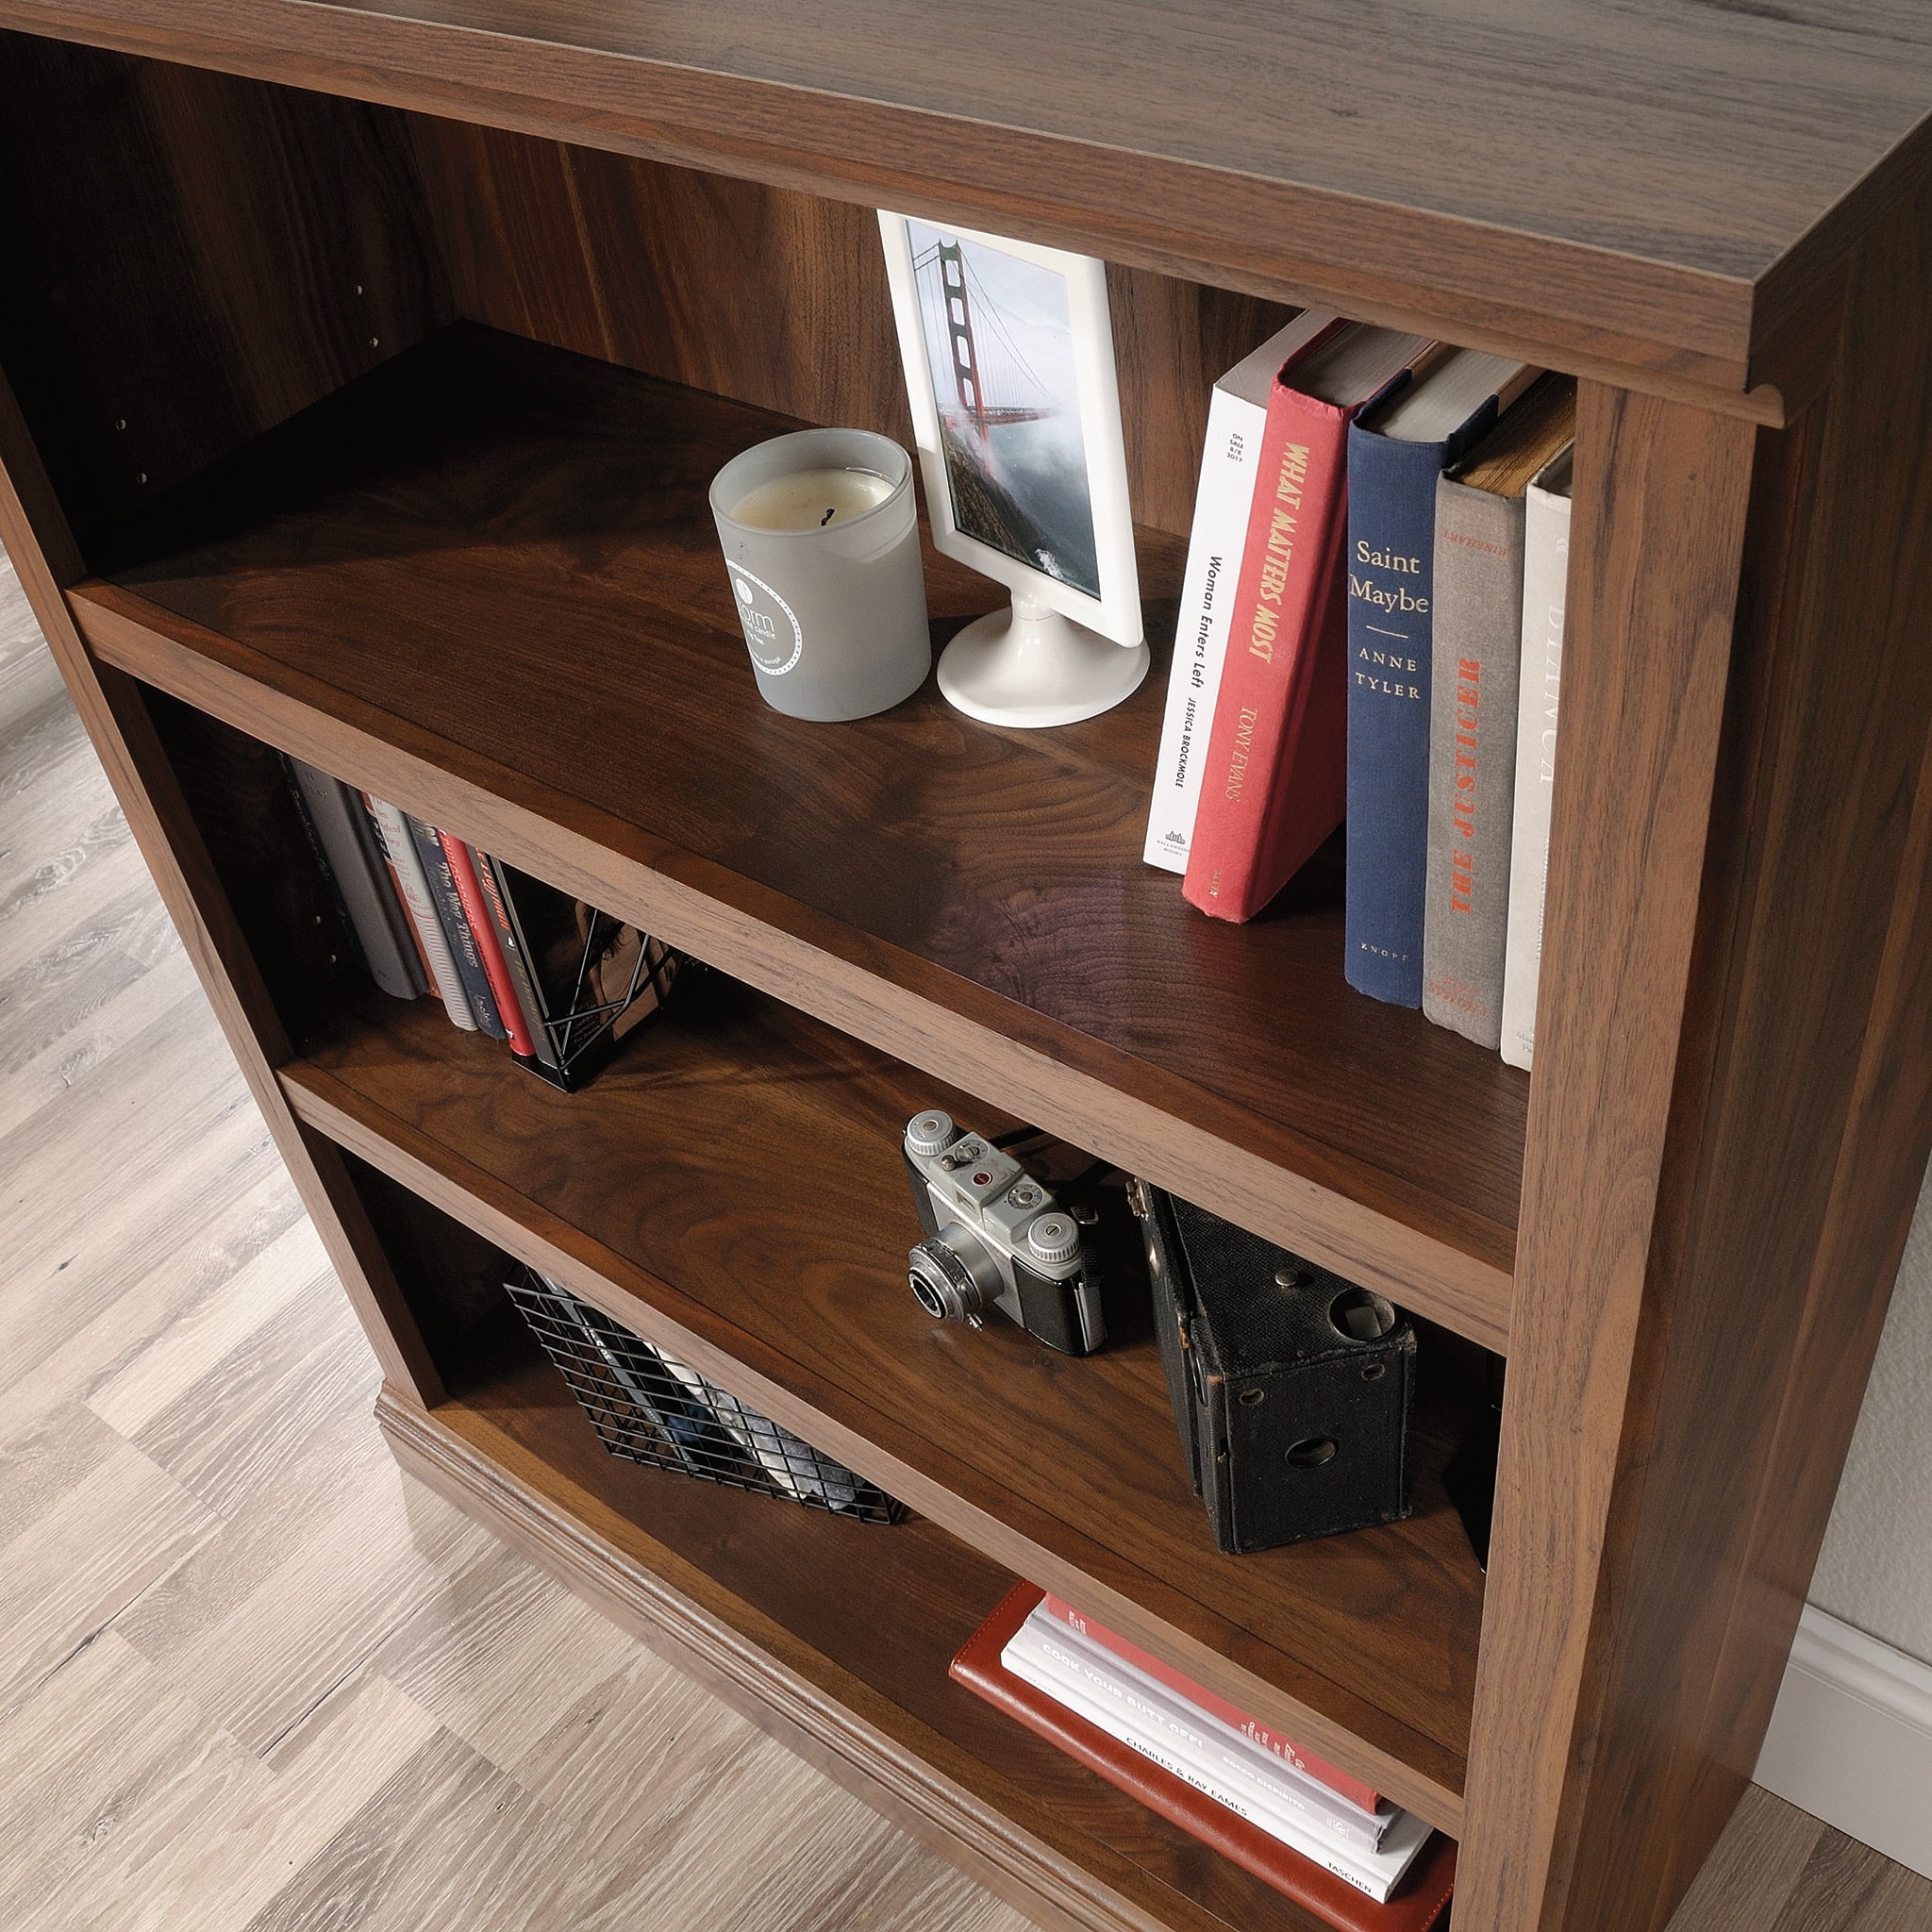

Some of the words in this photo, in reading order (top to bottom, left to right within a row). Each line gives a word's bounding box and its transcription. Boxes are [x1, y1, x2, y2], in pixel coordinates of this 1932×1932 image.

[1226, 452, 1243, 462] 2017
[1229, 439, 1243, 449] SALE
[1232, 433, 1243, 441] ON
[1275, 441, 1310, 510] WHAT
[1259, 508, 1299, 606] MATTERS
[1357, 540, 1420, 575] Saint
[1203, 555, 1223, 610] Woman
[1349, 573, 1429, 613] Maybe
[1195, 614, 1213, 658] Enters
[1248, 604, 1281, 664] MOST
[1191, 662, 1206, 689] Left
[1358, 647, 1417, 672] ANNE
[1356, 672, 1420, 699] TYLER
[1183, 696, 1196, 732] JESSICA
[1235, 705, 1257, 753] TONY
[1174, 734, 1191, 789] BROCKMOLE
[1454, 657, 1480, 840] JUSTICER
[1224, 750, 1248, 803] EVANS
[1450, 848, 1473, 913] THE
[440, 862, 452, 889] The
[446, 891, 463, 920] Way
[457, 923, 478, 968] Things
[1360, 942, 1409, 961] KNOPF
[1042, 1643, 1080, 1674] COOK
[1083, 1668, 1124, 1698] YOUR
[1126, 1696, 1166, 1724] BUTT
[1170, 1723, 1204, 1749] OFF!
[1126, 1736, 1174, 1771] CHARLES
[1175, 1766, 1186, 1777] &
[1188, 1774, 1208, 1791] RAY
[1209, 1789, 1248, 1817] EAMES
[1223, 1756, 1255, 1781] ROCCO
[1256, 1776, 1306, 1810] DISPIRITO
[1328, 1861, 1372, 1893] TASCHEN
